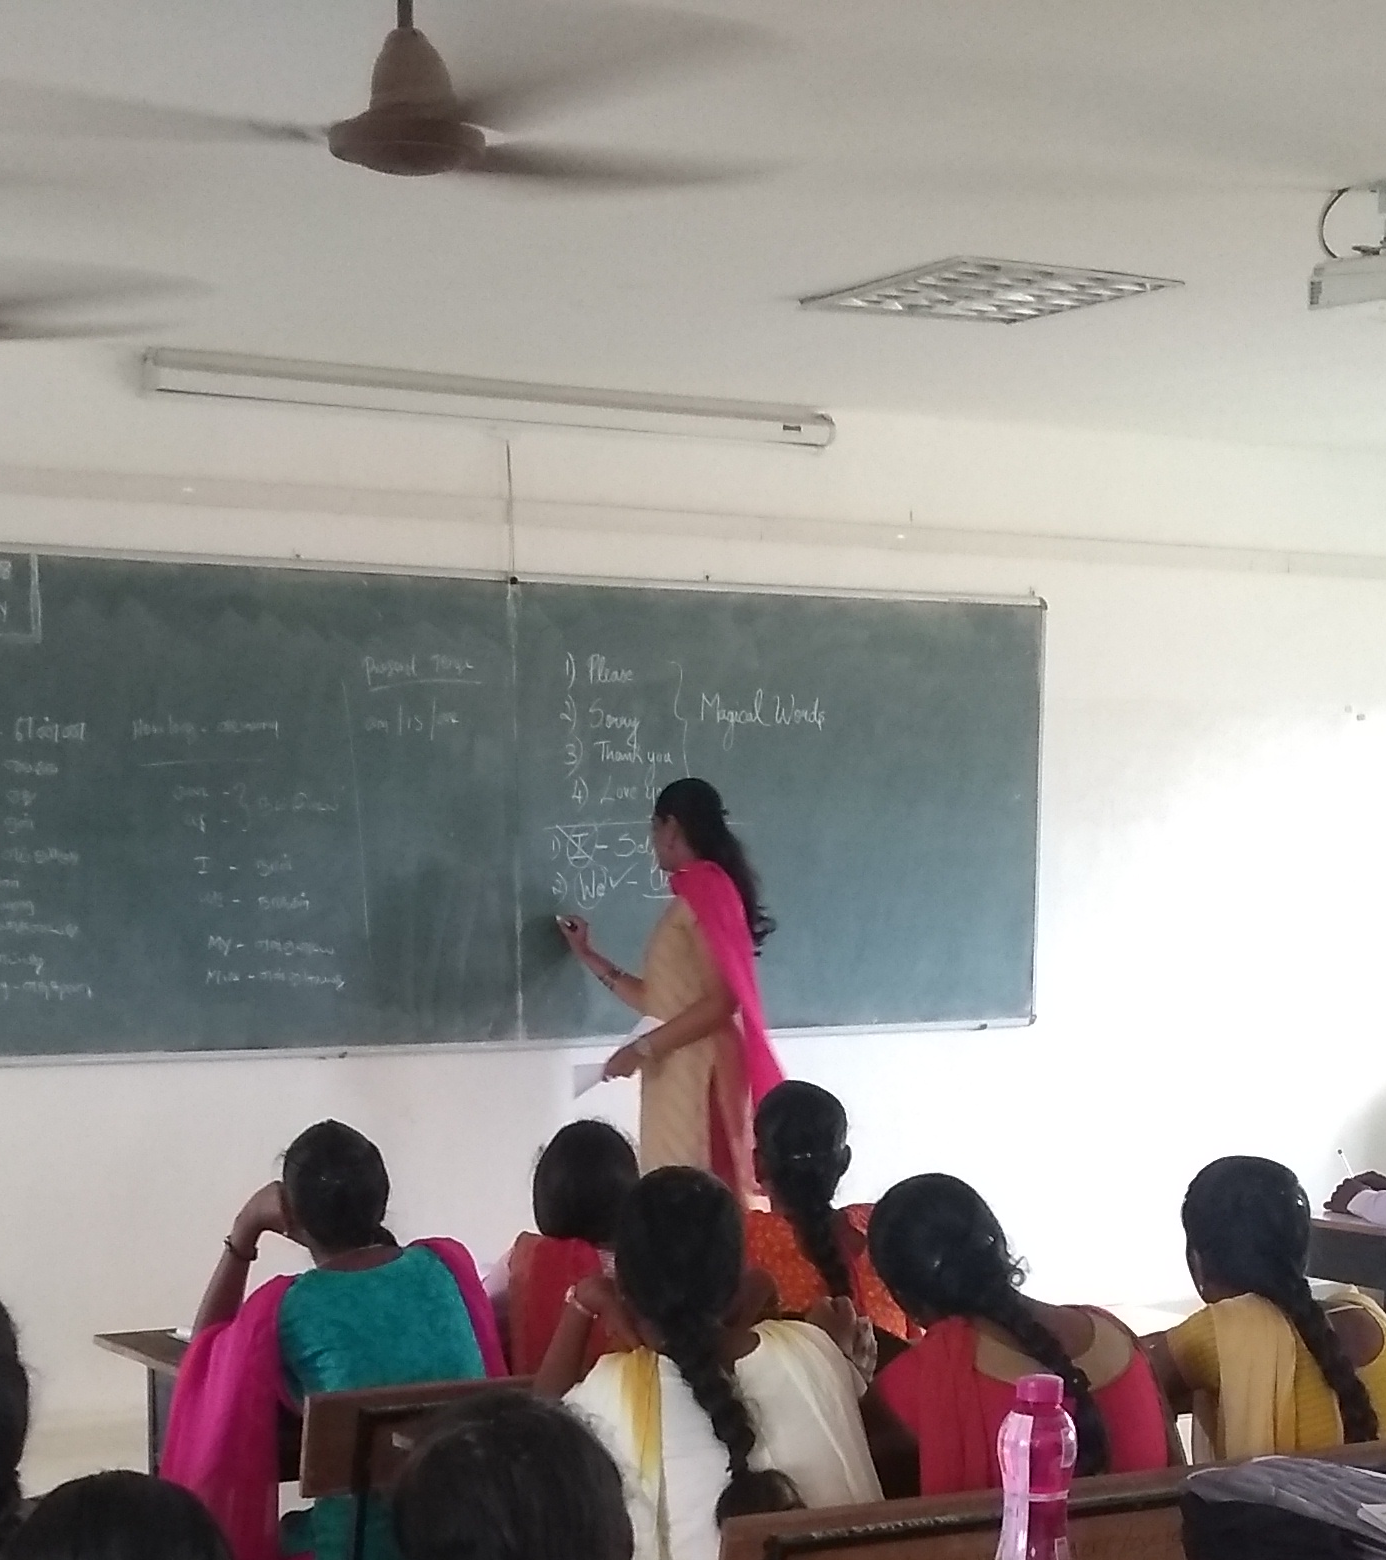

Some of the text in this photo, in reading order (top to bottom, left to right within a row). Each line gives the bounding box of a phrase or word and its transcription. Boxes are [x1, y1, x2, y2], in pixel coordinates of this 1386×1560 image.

[589, 653, 634, 684] Please
[589, 698, 641, 749] Sorry
[701, 688, 826, 751] Magical Words
[594, 741, 643, 765] Thank
[645, 751, 673, 786] you
[600, 775, 638, 804] Love
[579, 869, 606, 900] We
